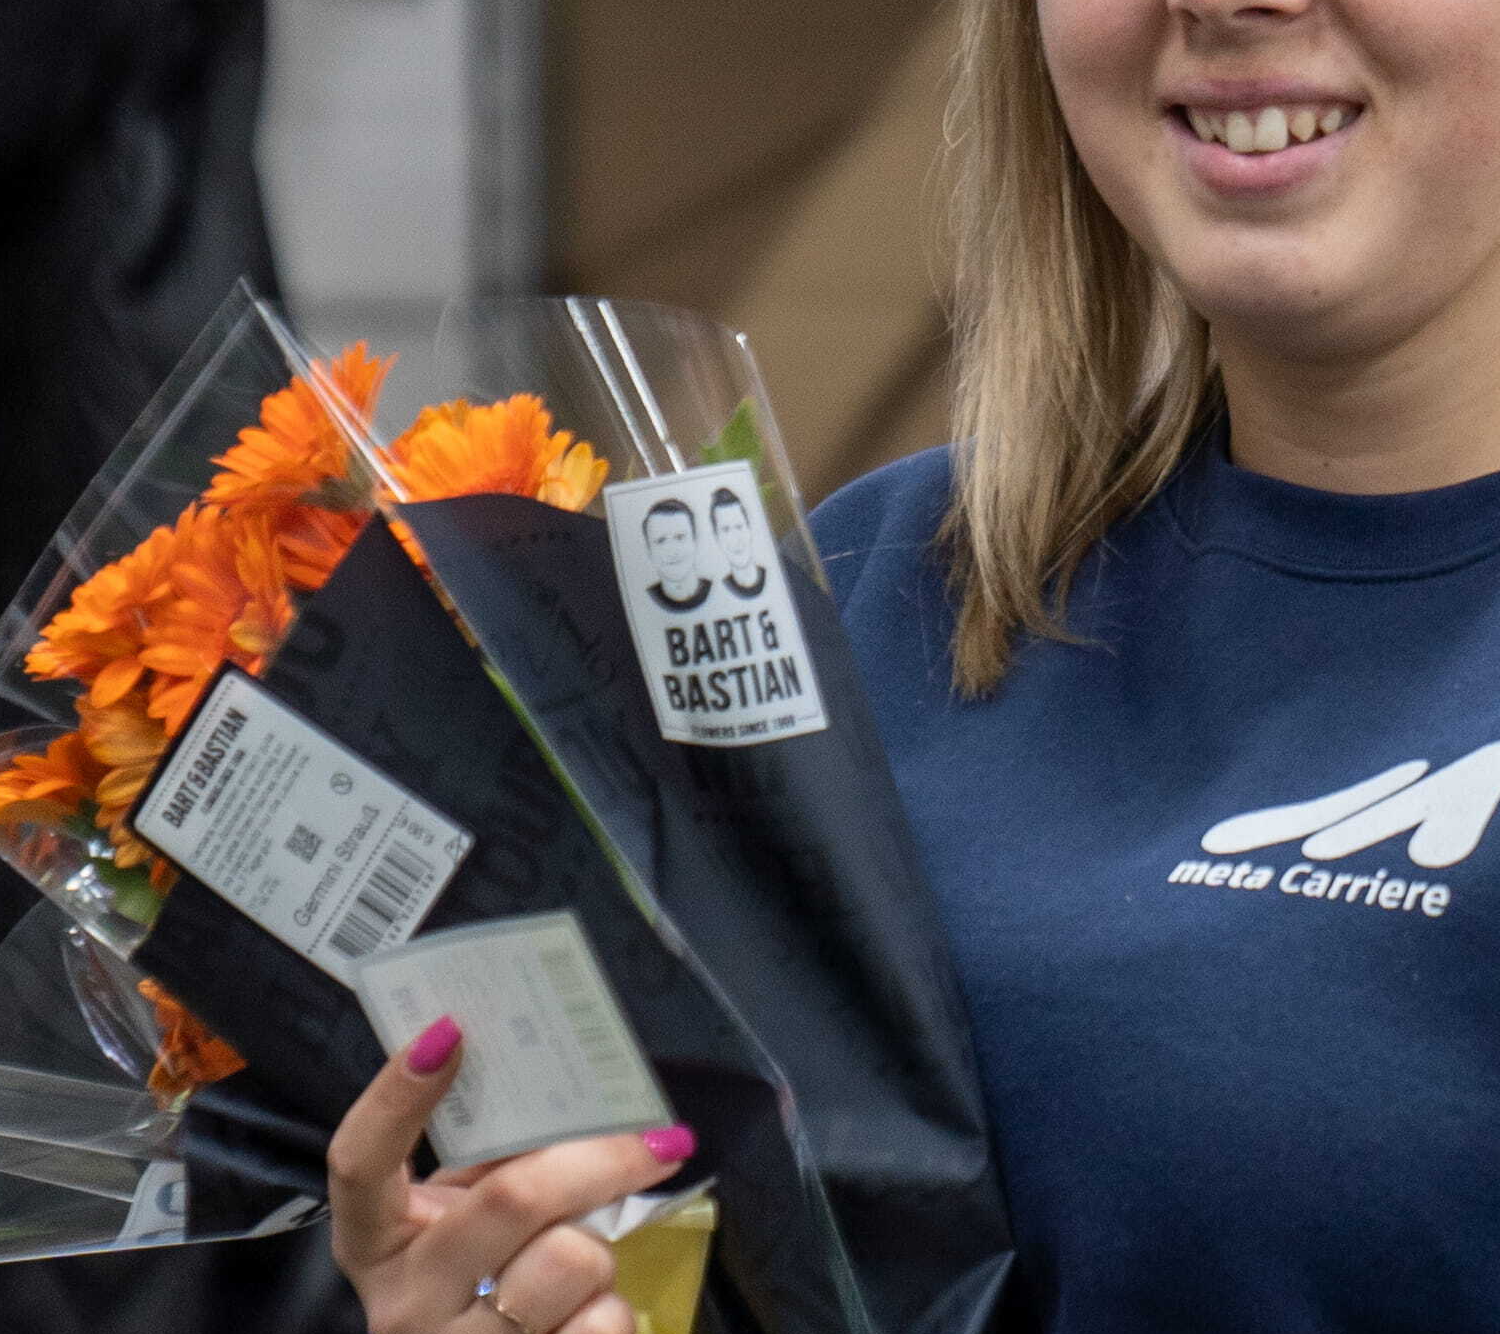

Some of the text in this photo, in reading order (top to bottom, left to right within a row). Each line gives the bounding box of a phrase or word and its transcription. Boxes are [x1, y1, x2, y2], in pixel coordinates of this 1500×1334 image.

[665, 609, 780, 668] BART &
[662, 655, 803, 714] BASTIAN
[162, 781, 199, 828] BART
[194, 707, 247, 778] BASTIAN
[1167, 860, 1450, 917] meta Carriere
